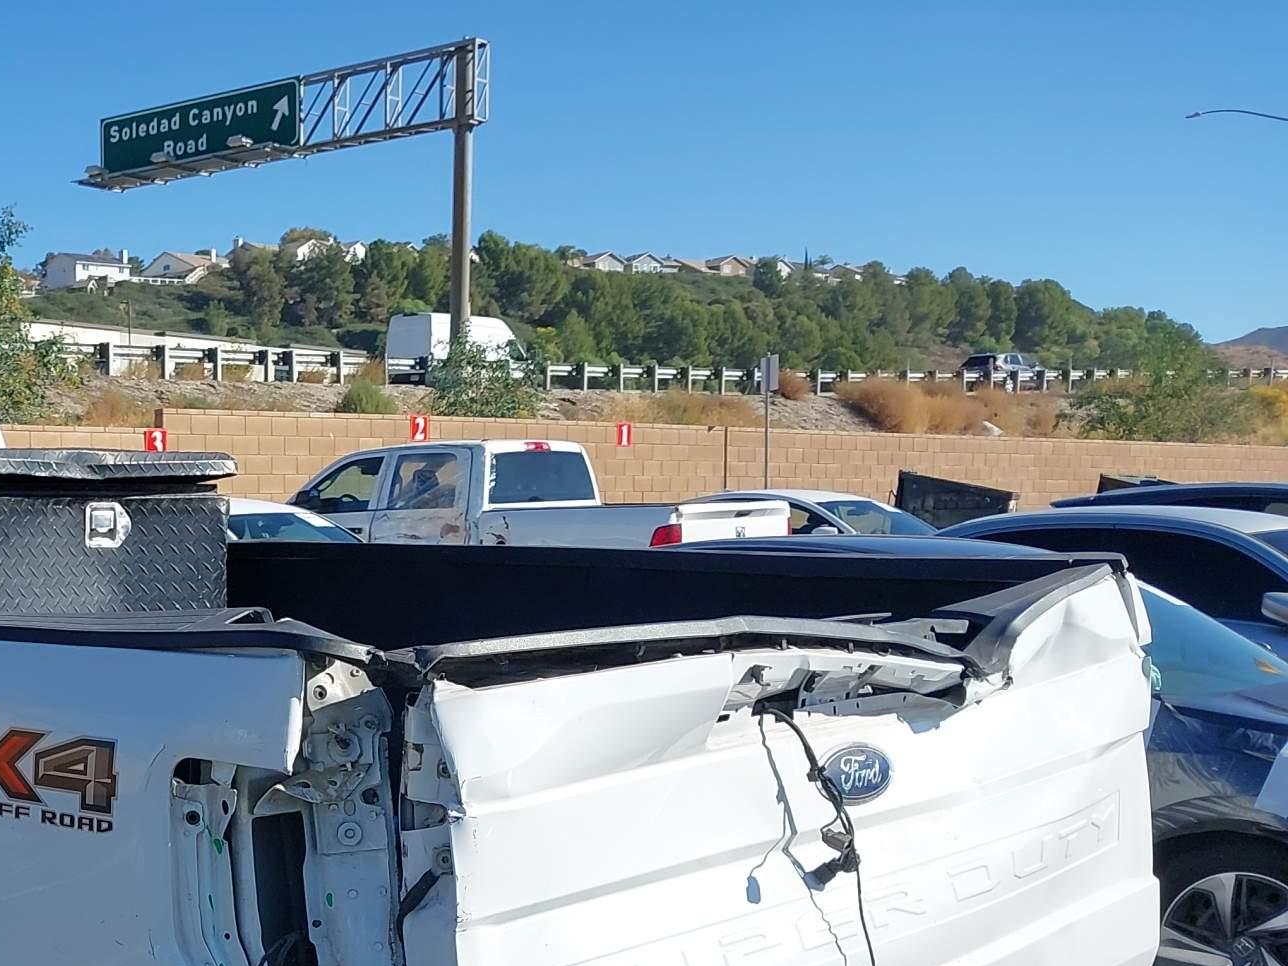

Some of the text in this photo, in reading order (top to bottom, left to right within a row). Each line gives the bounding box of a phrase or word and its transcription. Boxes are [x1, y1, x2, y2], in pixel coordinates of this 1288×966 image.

[109, 100, 258, 143] Soledad Canyon
[163, 133, 207, 157] Road
[414, 417, 425, 441] 2
[621, 424, 628, 446] 1
[151, 431, 163, 452] 3
[840, 754, 882, 793] Ford
[40, 808, 114, 833] ROAD
[946, 803, 1116, 902] DUTY
